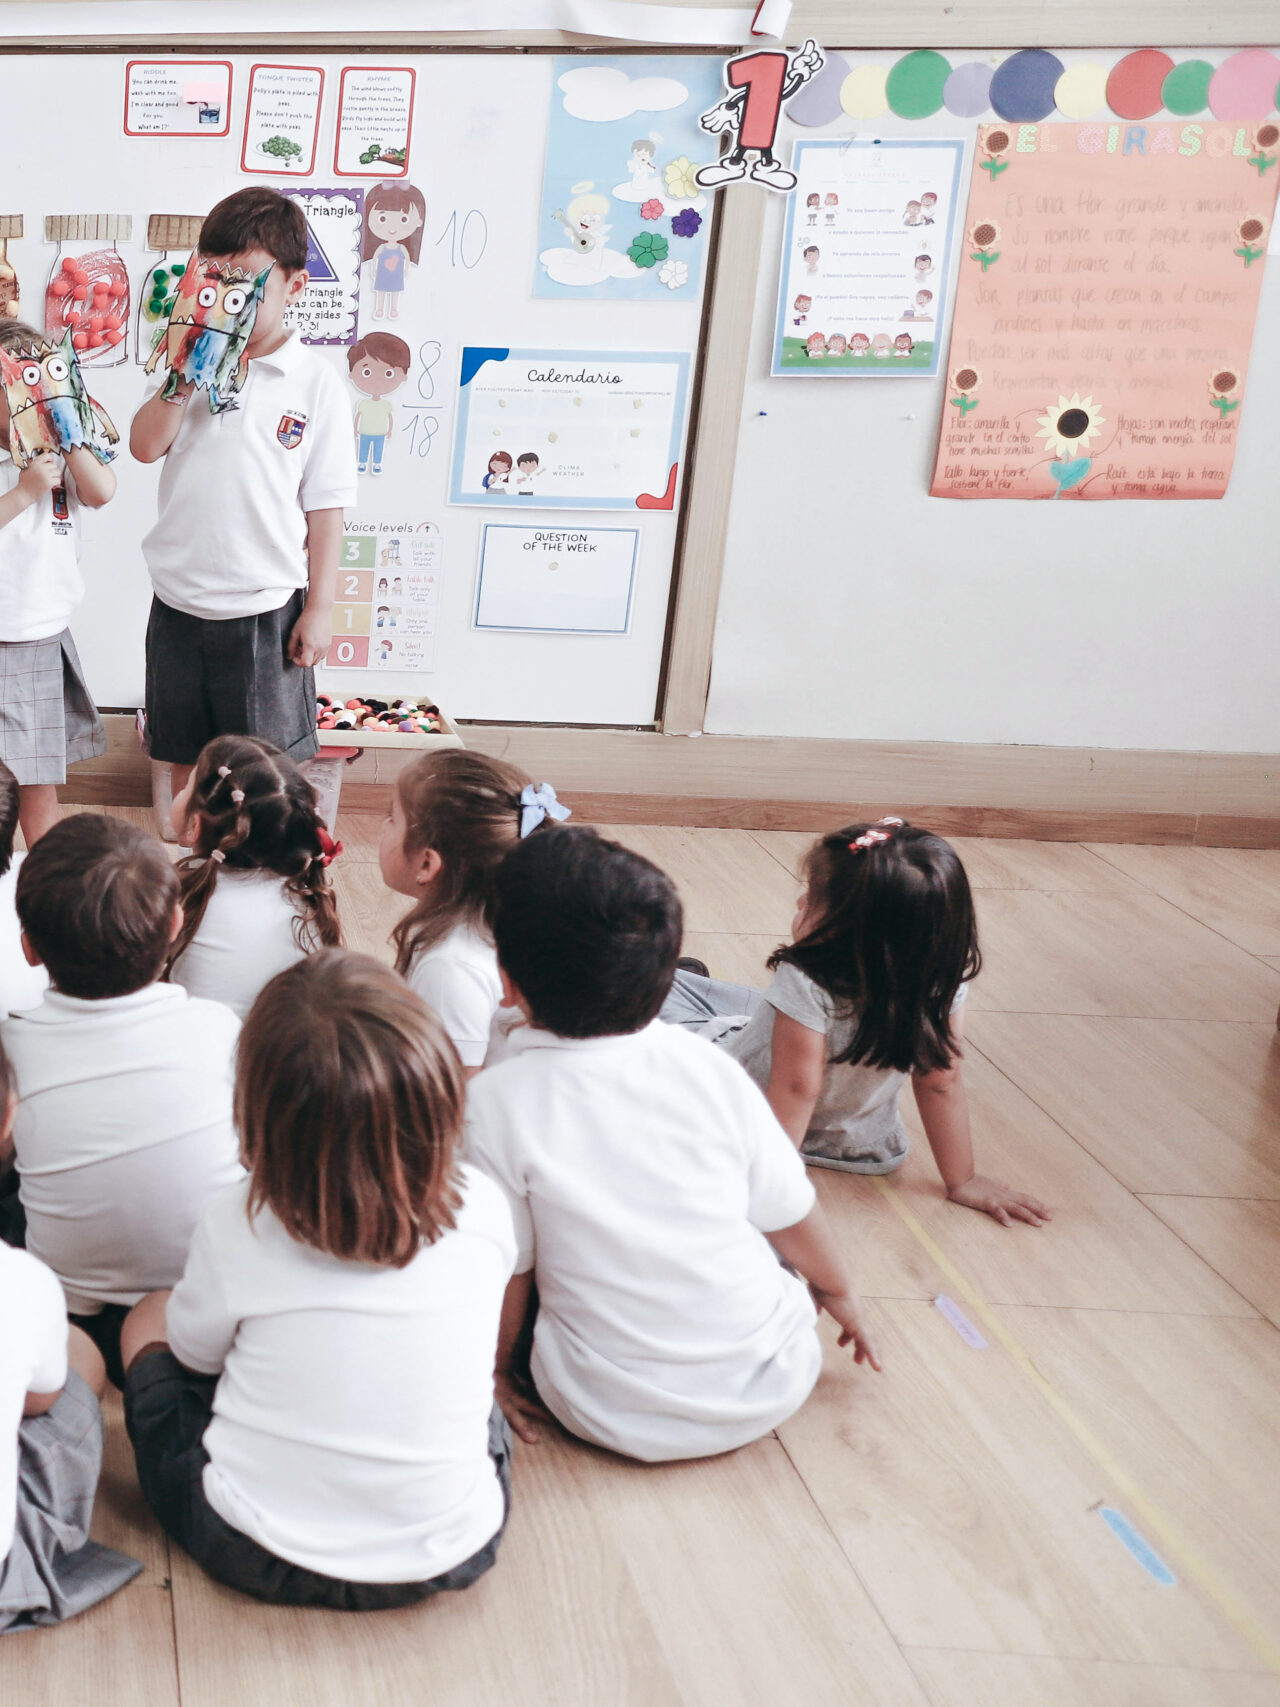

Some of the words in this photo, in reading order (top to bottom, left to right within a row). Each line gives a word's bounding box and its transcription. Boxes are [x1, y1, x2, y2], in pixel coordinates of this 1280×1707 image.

[1016, 124, 1058, 153] EL
[1076, 123, 1252, 158] GIRASOL
[304, 204, 354, 218] Triangle
[435, 208, 488, 270] 10
[304, 287, 344, 299] Triangle
[294, 300, 307, 309] as
[309, 300, 328, 309] can
[331, 299, 345, 309] be.
[297, 311, 312, 322] my
[314, 310, 341, 320] sides
[309, 320, 320, 331] 3!
[417, 340, 442, 400] 8
[527, 368, 624, 386] Calendario
[401, 414, 440, 458] 18
[343, 521, 376, 533] Voice
[379, 522, 414, 534] levels
[522, 542, 538, 552] OF
[542, 542, 563, 553] THE
[566, 543, 597, 553] WEEK
[534, 532, 588, 544] QUESTION
[346, 541, 361, 561] 3
[344, 575, 359, 596] 2
[344, 608, 354, 629] 1
[337, 641, 355, 662] 0
